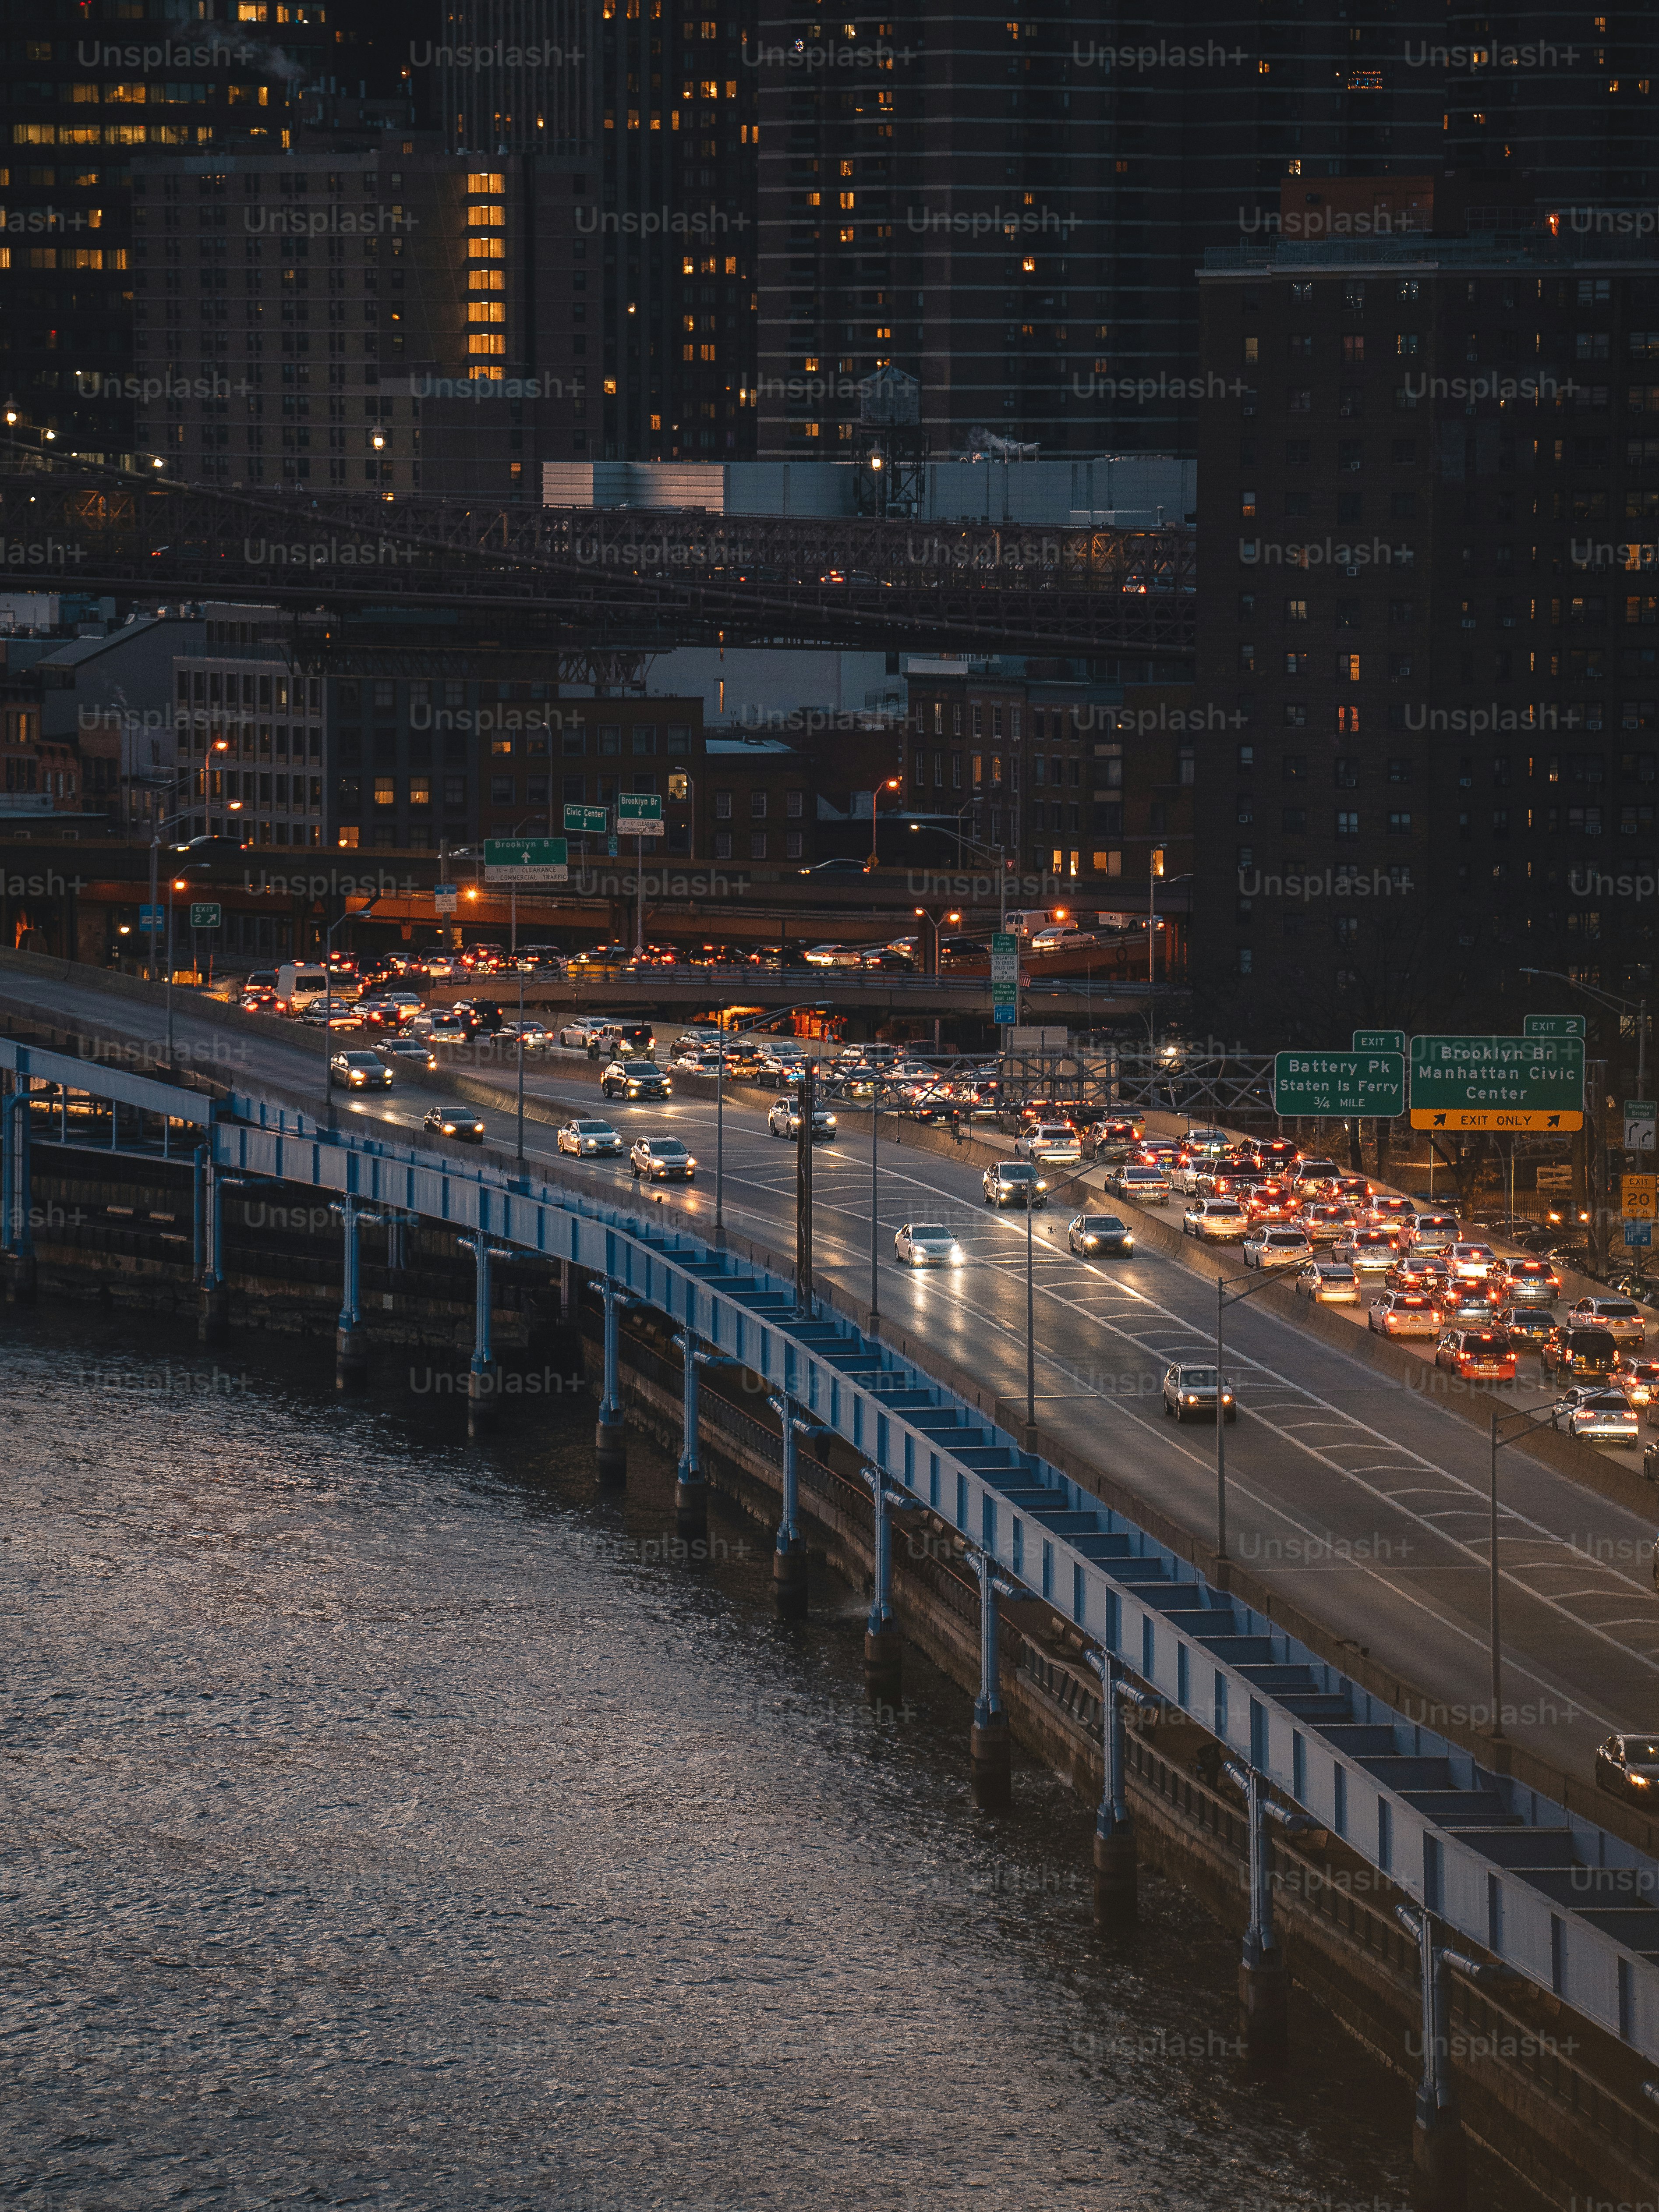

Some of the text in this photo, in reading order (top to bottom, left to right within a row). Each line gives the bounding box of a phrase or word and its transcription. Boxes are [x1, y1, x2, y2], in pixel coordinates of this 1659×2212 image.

[621, 797, 647, 806] Brooklyn
[495, 841, 536, 850] Brooklyn
[195, 914, 202, 923] 2
[1532, 1021, 1577, 1033] EXIT 2
[1362, 1037, 1399, 1048] EXIT 1
[1441, 1046, 1553, 1062] Brooklyn Br
[1290, 1059, 1389, 1076] Battery Pk
[1419, 1066, 1575, 1080] Manhattan Civic
[1280, 1079, 1398, 1094] Staten Is Ferry
[1466, 1087, 1527, 1100] Center
[1461, 1115, 1532, 1126] EXIT ONLY
[1627, 1193, 1650, 1206] 20
[1627, 1232, 1633, 1242] H
